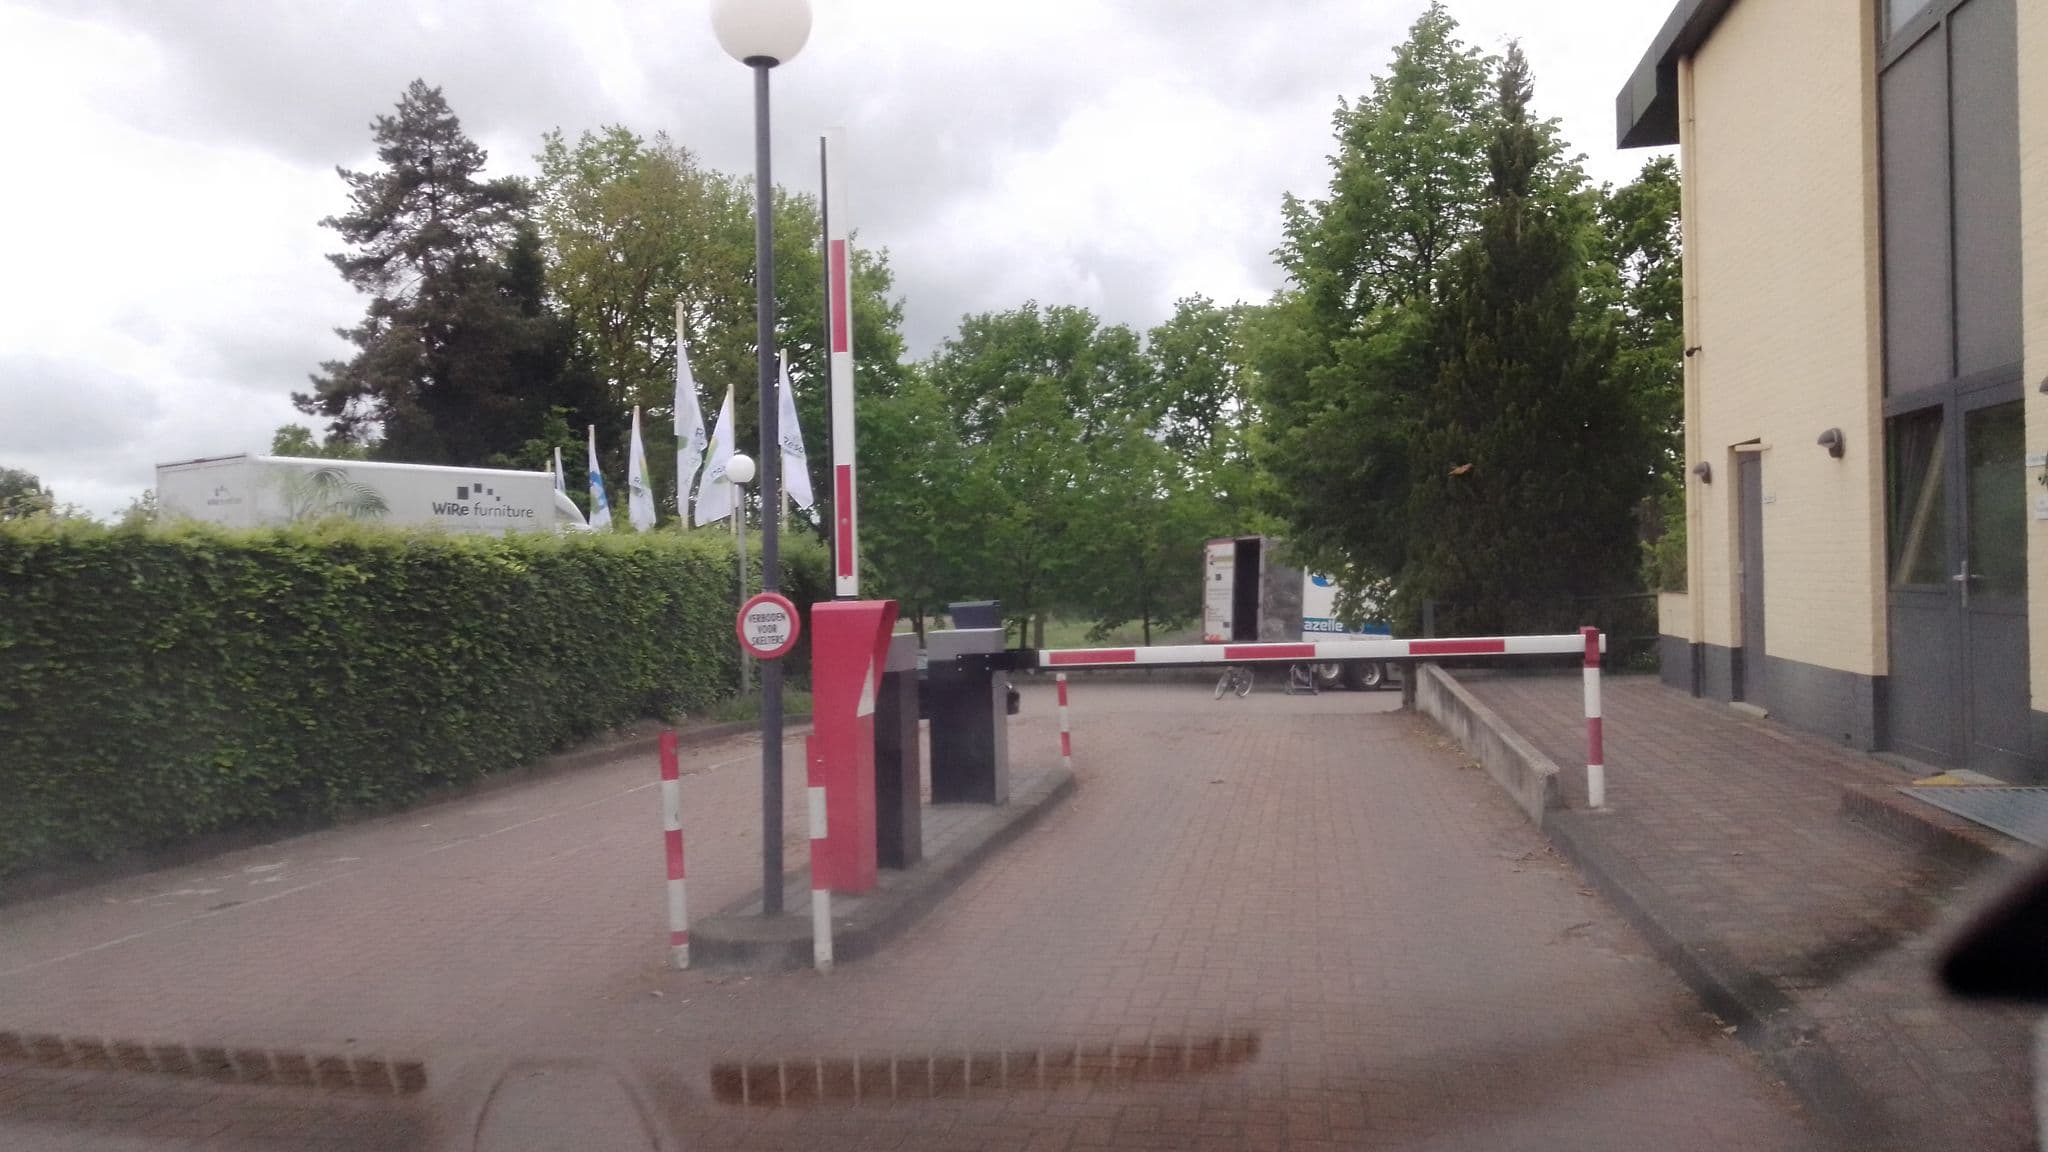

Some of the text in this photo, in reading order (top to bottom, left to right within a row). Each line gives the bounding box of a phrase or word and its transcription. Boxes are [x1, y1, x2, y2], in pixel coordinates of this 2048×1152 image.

[432, 501, 534, 518] WiRe furniture
[748, 612, 785, 623] VERBODEN
[757, 624, 777, 634] VOOR
[1303, 620, 1344, 632] azelle
[752, 635, 785, 646] SKELTERS
